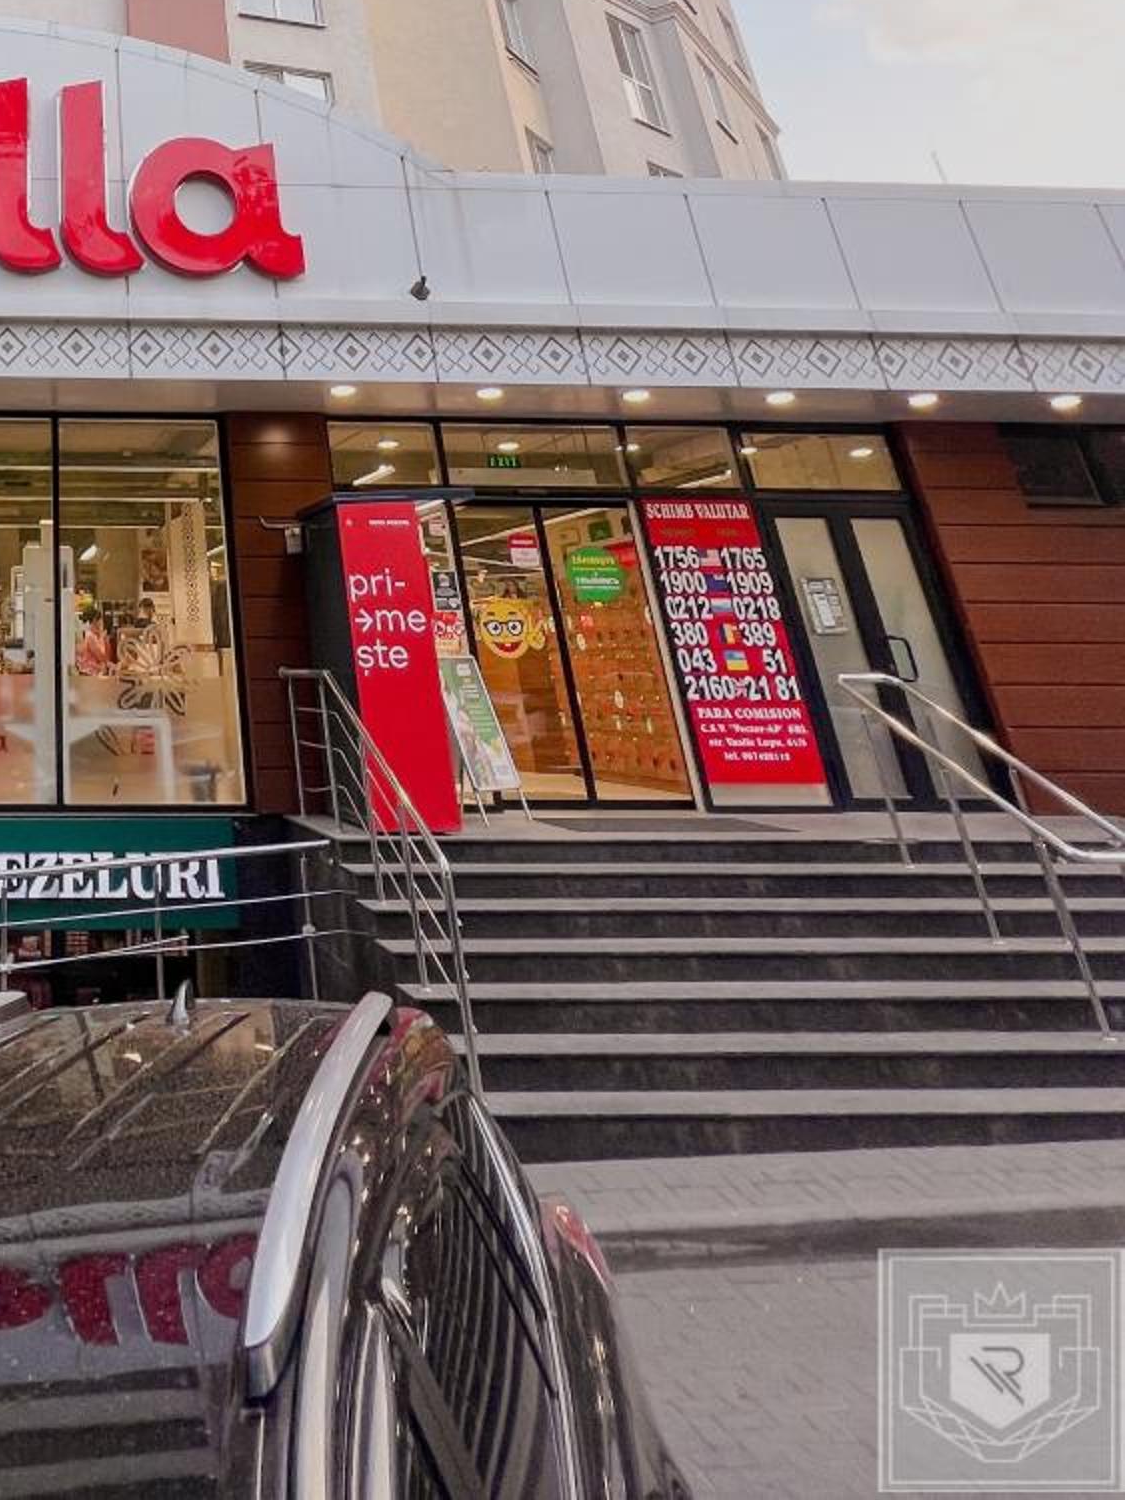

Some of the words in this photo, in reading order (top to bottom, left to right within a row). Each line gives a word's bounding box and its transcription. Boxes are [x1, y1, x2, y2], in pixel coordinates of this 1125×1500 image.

[646, 503, 693, 519] SCHIMB
[693, 504, 750, 519] VALUTAR
[654, 546, 700, 569] 1756
[721, 547, 767, 569] 1765
[348, 568, 406, 602] pri-
[660, 571, 707, 594] 1900
[727, 571, 774, 594] 1909
[665, 596, 713, 620] 0212
[733, 597, 781, 620] 0218
[670, 621, 709, 646] 380
[739, 622, 777, 646] 389
[676, 648, 718, 673] 043
[684, 676, 735, 700] 2160
